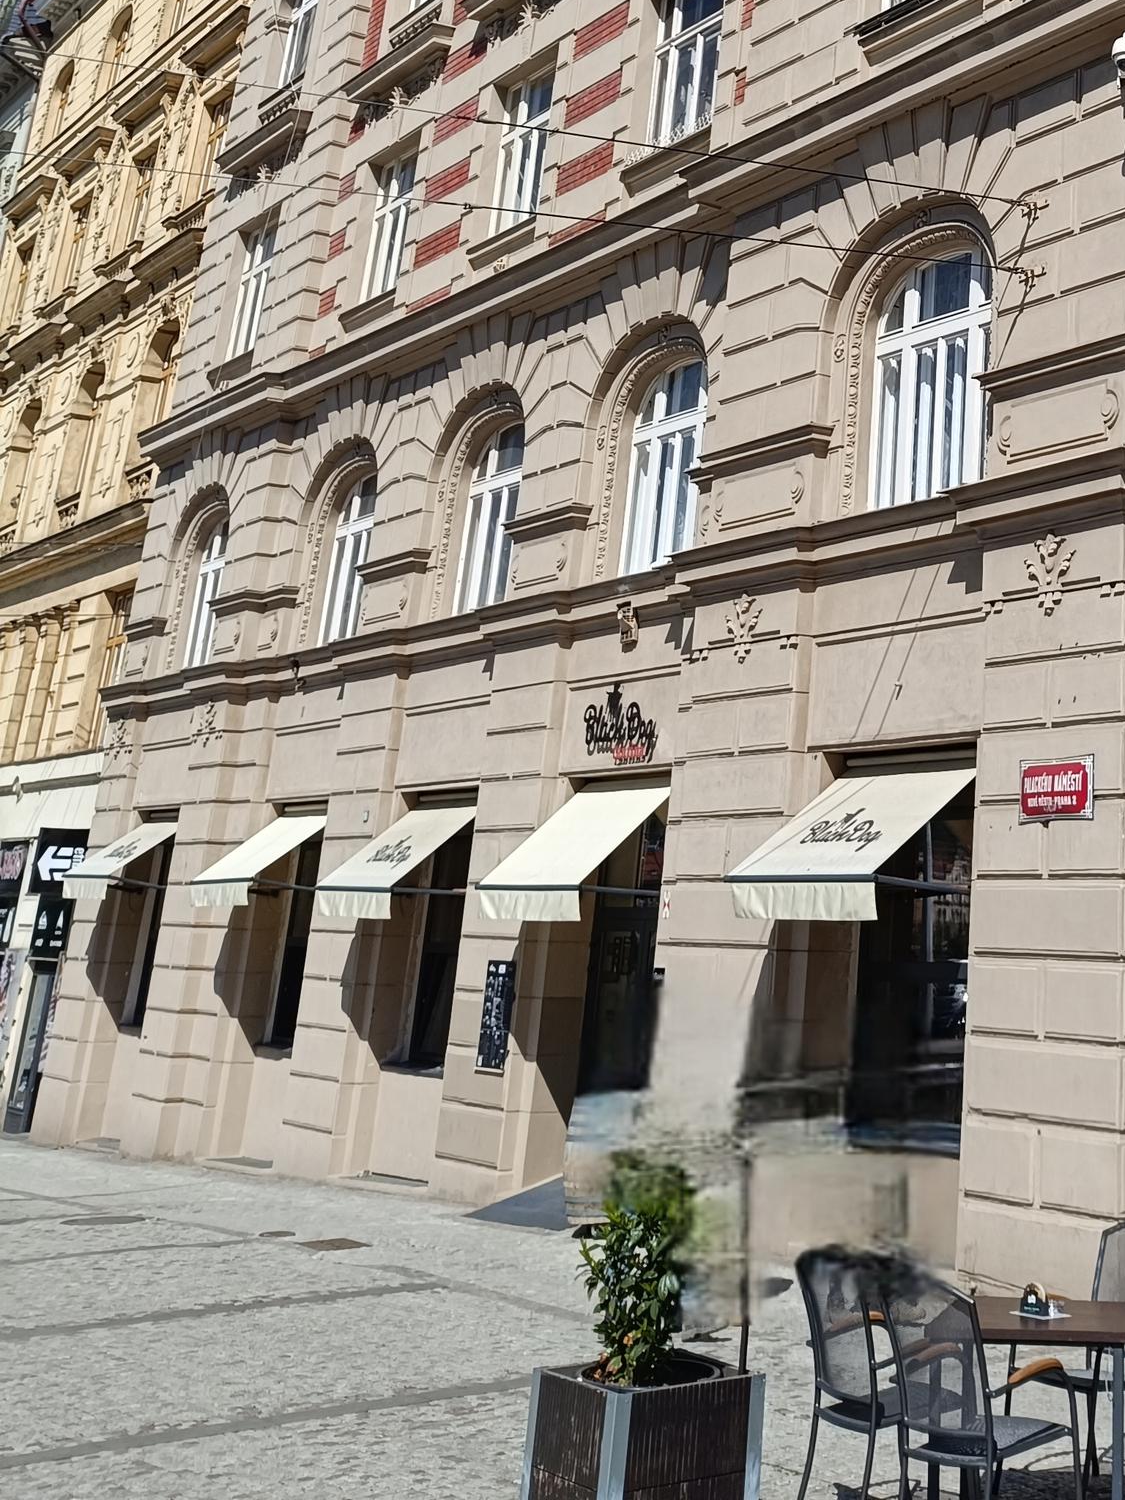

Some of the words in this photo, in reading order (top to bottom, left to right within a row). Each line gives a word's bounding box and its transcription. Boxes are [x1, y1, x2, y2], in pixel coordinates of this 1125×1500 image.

[584, 704, 626, 751] Black
[626, 702, 658, 762] Dog
[1054, 770, 1083, 792] NÁMĚSTÍ
[800, 819, 857, 844] Black
[845, 820, 882, 852] Dog
